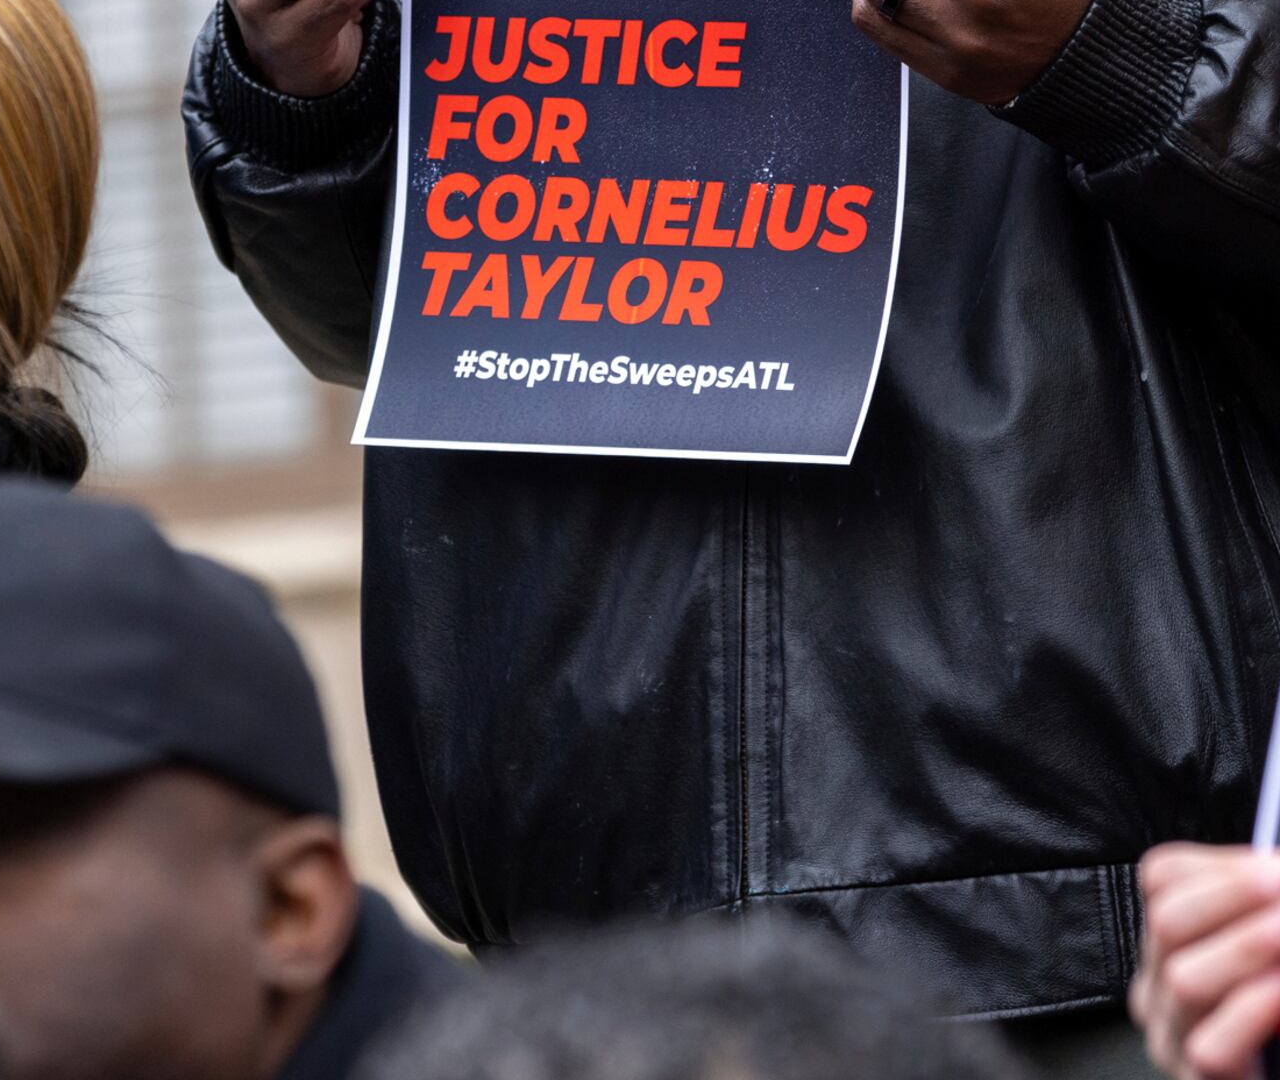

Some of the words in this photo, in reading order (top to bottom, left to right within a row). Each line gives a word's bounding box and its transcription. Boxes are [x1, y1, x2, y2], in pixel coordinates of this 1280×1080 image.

[425, 16, 747, 88] JUSTICE
[427, 94, 588, 164] FOR
[425, 172, 873, 253] CORNELIUS
[421, 251, 724, 327] TAYLOR
[453, 349, 795, 394] #StopTheSweepsATL
